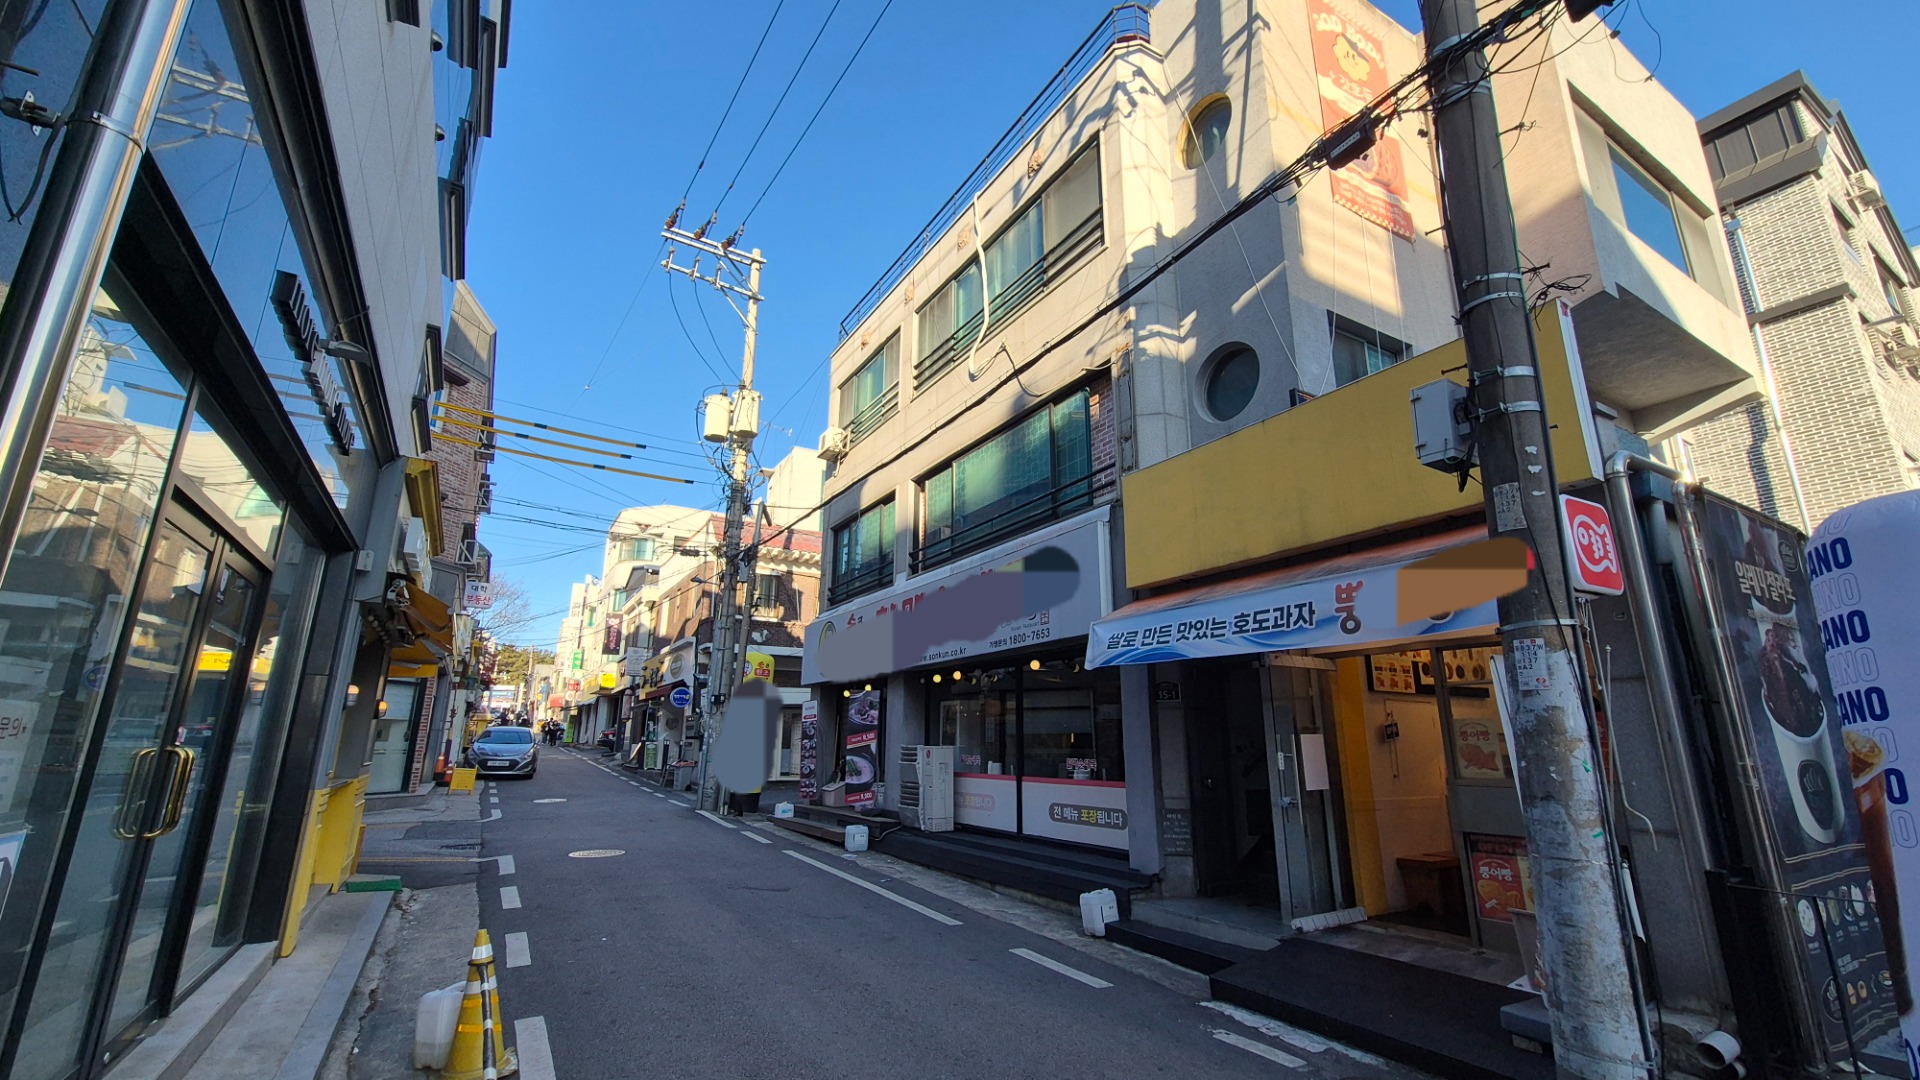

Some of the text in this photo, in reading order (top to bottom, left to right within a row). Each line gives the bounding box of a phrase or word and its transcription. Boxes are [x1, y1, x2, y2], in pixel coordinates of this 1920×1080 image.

[466, 595, 491, 606] 부동산
[1107, 628, 1138, 652] 쌀로
[1141, 624, 1174, 647] 만든
[1175, 617, 1228, 643] 맛있는
[1232, 601, 1316, 635] 호도과자
[1009, 628, 1050, 645] 1800-7653
[1158, 690, 1176, 699] 15-1
[1053, 805, 1123, 827] 전 메뉴 포장됩니다
